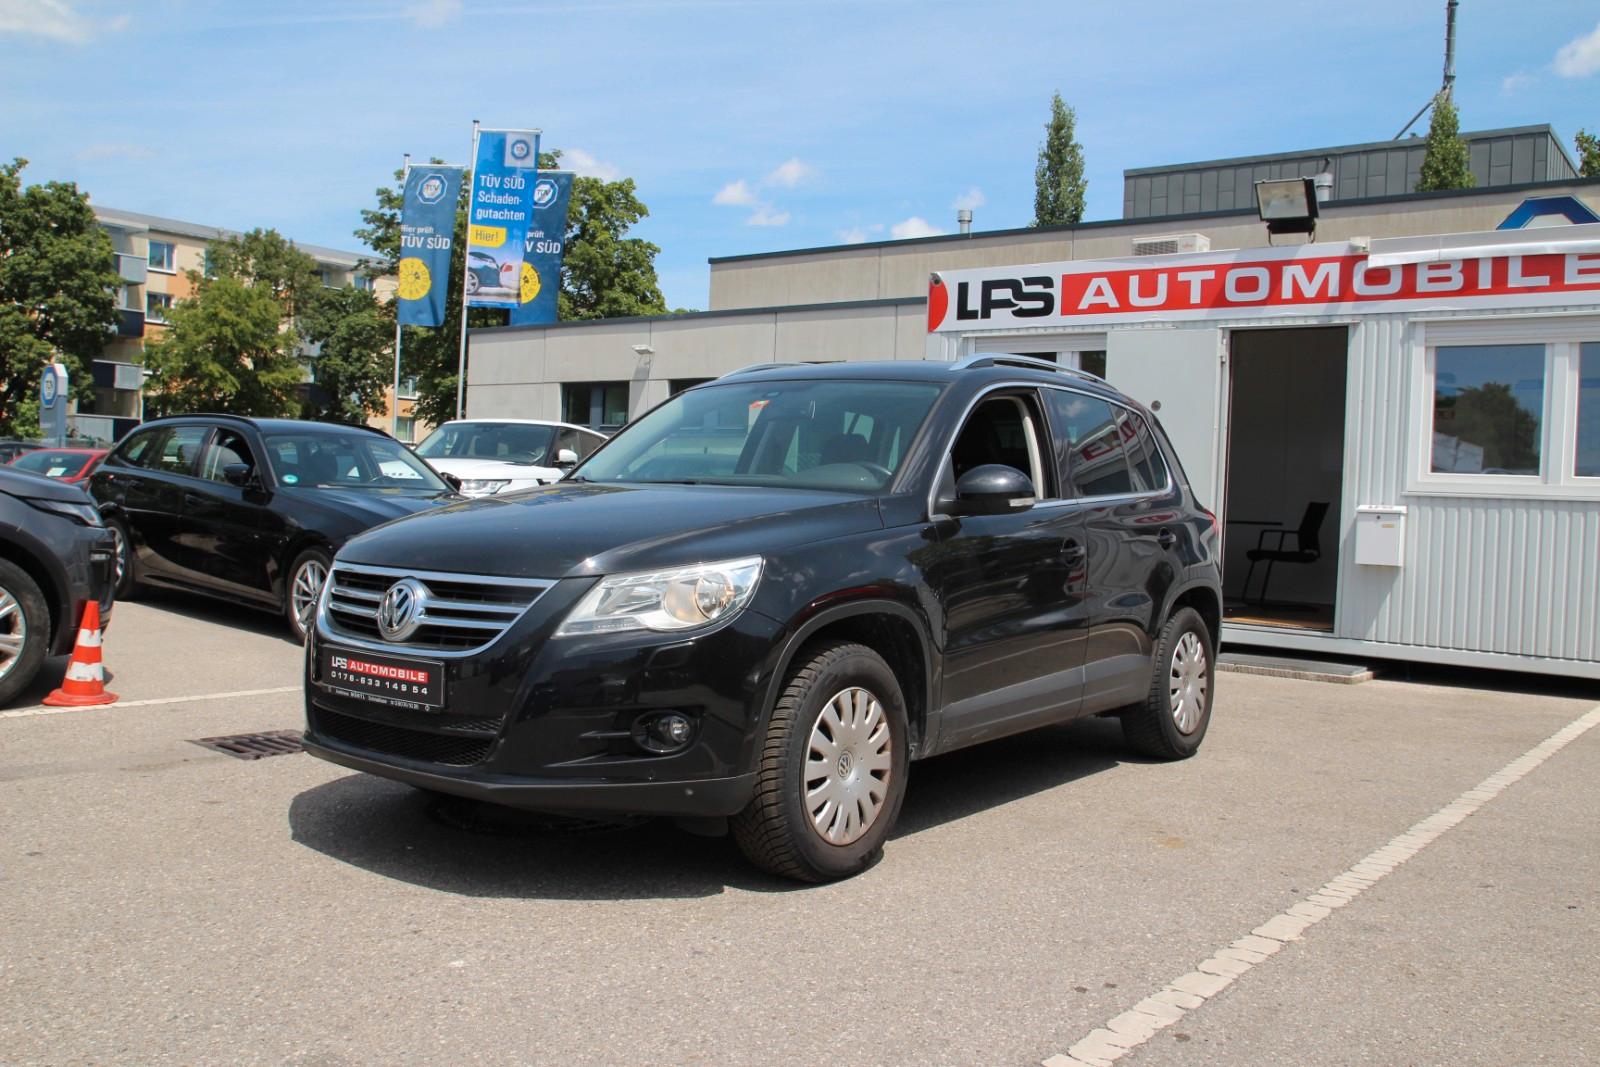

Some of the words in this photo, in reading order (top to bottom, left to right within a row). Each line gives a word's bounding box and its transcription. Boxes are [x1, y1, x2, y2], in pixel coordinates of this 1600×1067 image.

[480, 173, 501, 187] TÜV
[503, 174, 525, 190] SÜD
[478, 189, 523, 206] Schaden-
[476, 207, 525, 222] gutachten
[401, 224, 416, 233] Hier
[417, 225, 434, 235] prüft
[475, 229, 499, 242] Hier!
[527, 231, 544, 240] prüft
[401, 234, 424, 249] TÜV
[427, 235, 451, 250] SÜD
[536, 240, 561, 254] SÜD
[956, 276, 1055, 320] LPS
[331, 655, 348, 670] LPS
[349, 661, 425, 681] AUTOMOBILE
[412, 685, 428, 696] 54
